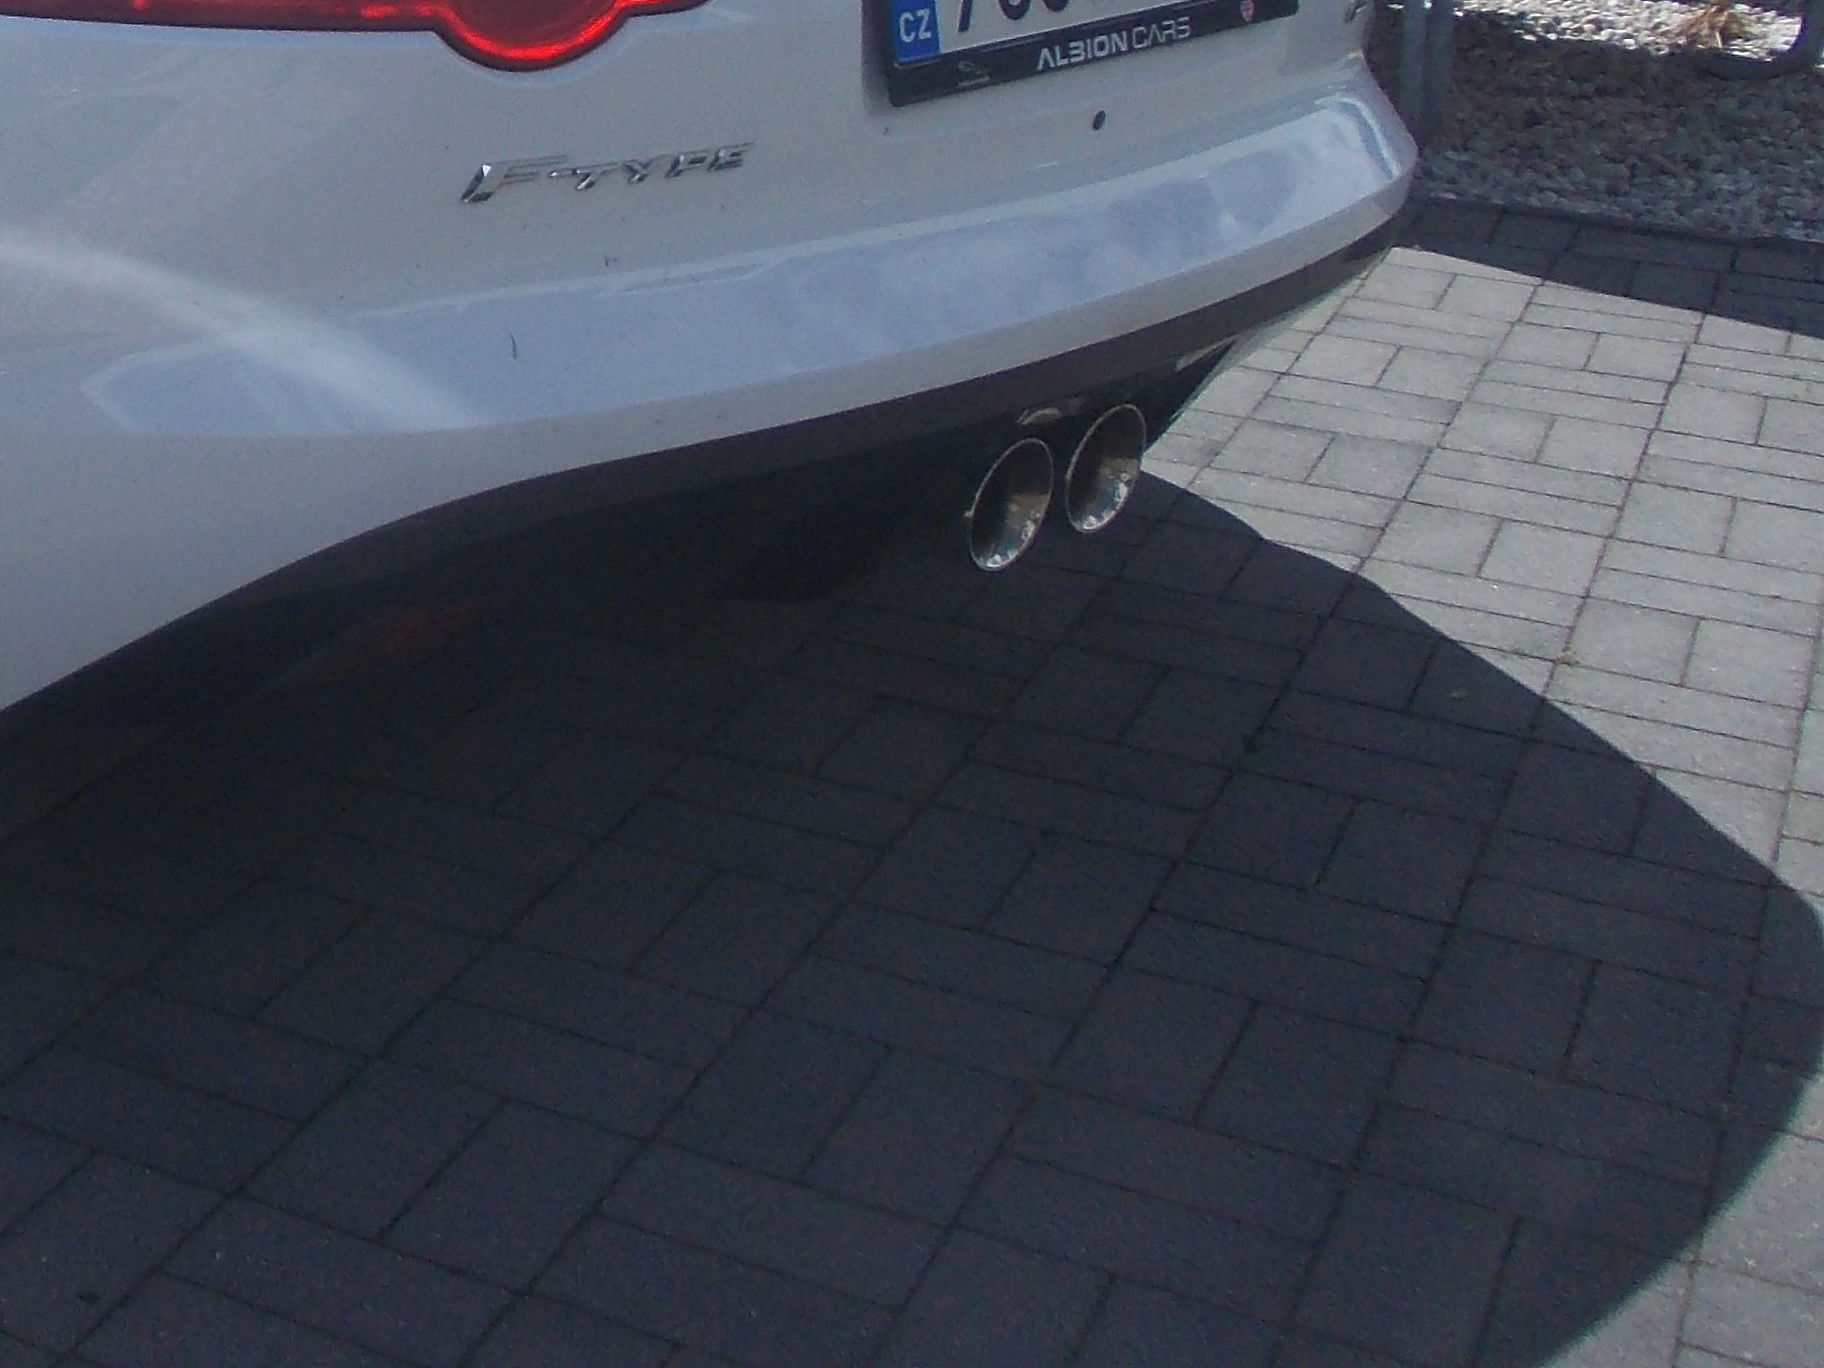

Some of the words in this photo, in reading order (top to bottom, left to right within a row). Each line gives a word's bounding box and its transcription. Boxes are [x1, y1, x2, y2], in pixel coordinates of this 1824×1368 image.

[899, 8, 932, 43] CZ
[1037, 30, 1128, 71] ALBION
[1132, 16, 1191, 49] CARS
[460, 140, 755, 204] F-TYPE
